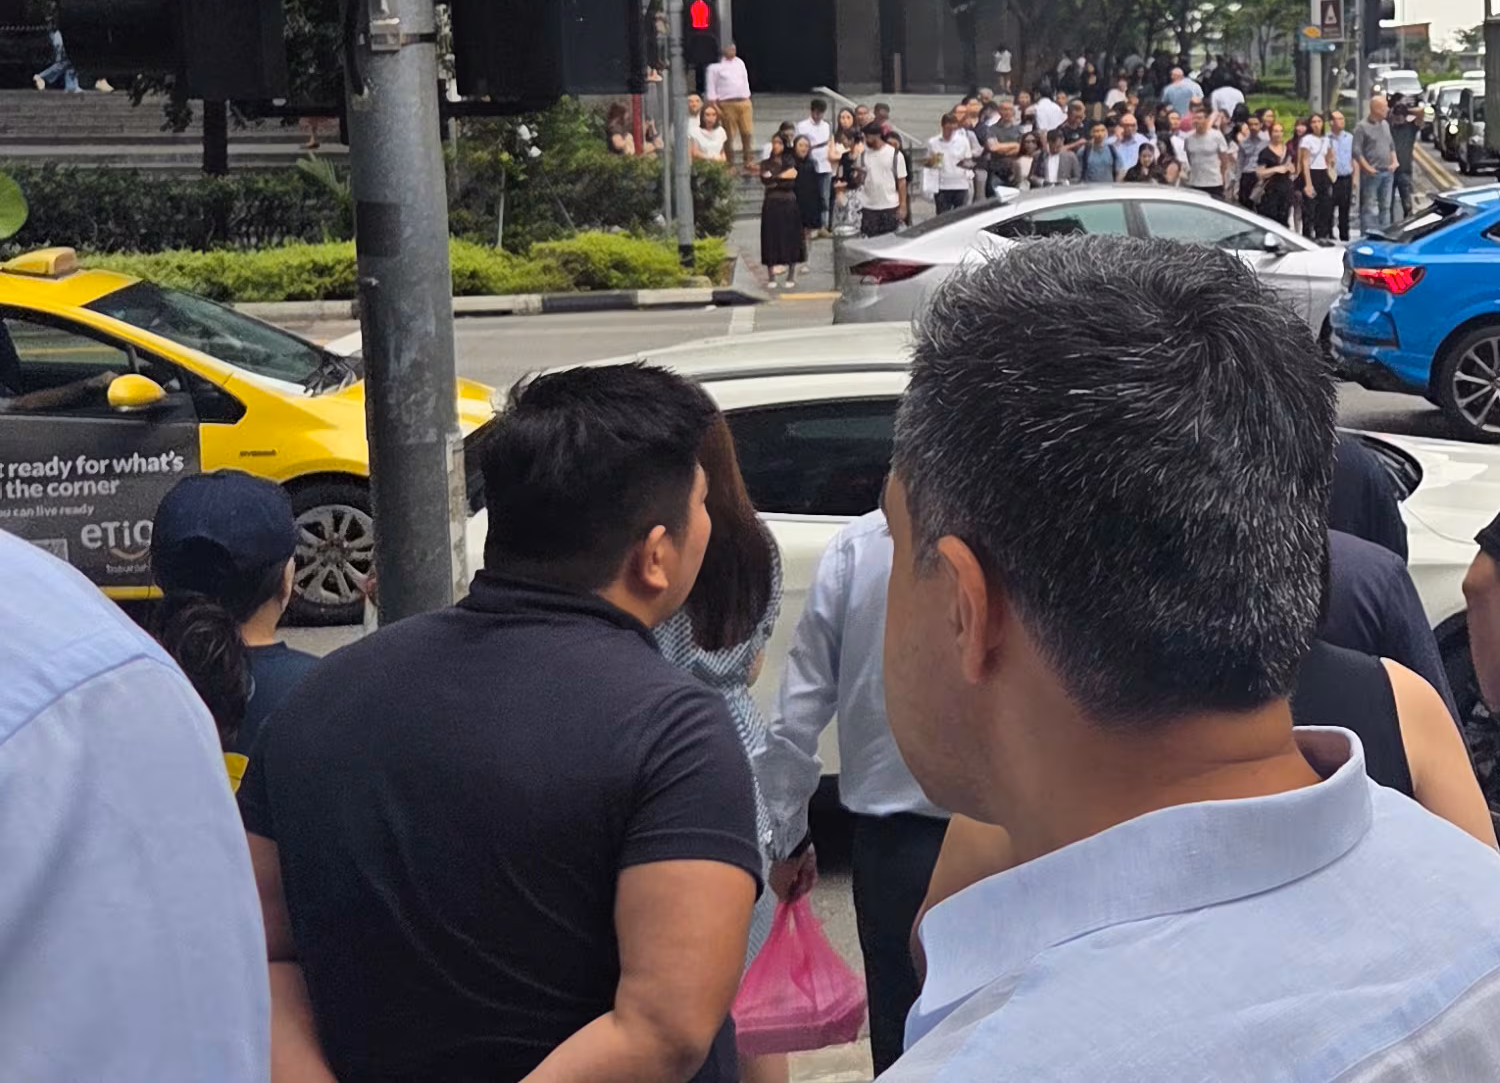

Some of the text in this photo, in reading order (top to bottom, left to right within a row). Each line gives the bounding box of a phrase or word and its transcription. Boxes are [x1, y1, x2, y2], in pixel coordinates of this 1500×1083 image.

[8, 455, 73, 479] ready
[75, 455, 110, 475] for
[112, 450, 184, 473] what's
[6, 479, 44, 499] the
[47, 478, 121, 497] corner
[13, 507, 35, 517] can
[36, 504, 57, 516] live
[59, 503, 95, 516] ready
